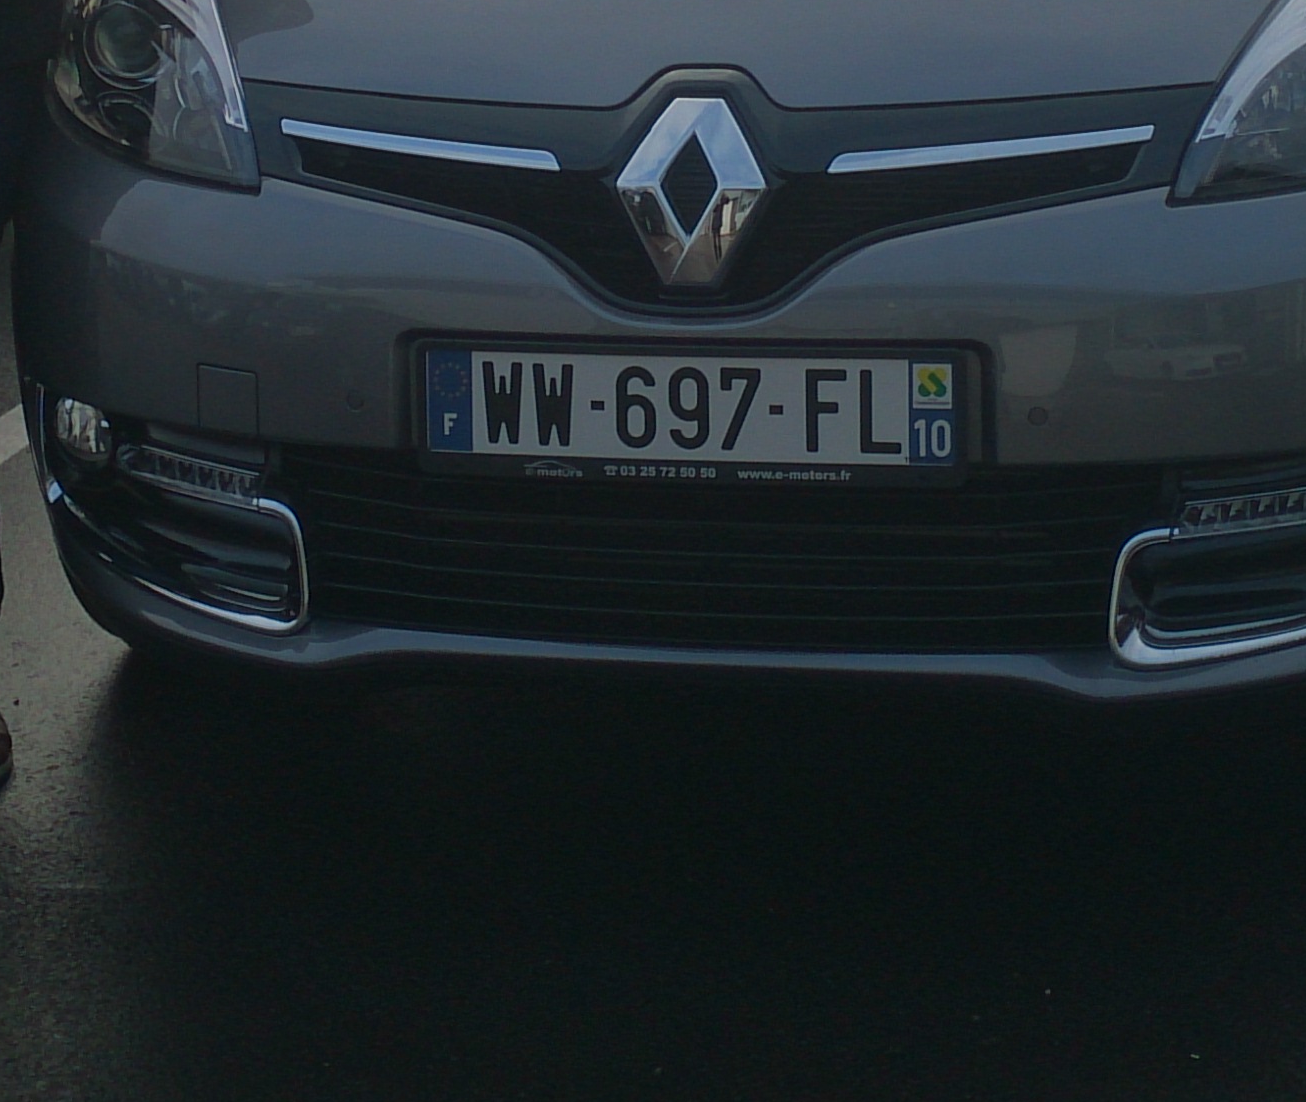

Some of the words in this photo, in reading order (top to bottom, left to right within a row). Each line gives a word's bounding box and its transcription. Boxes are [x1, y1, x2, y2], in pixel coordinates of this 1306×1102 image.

[443, 412, 458, 436] F
[482, 361, 902, 454] WW-697-FL
[914, 418, 952, 458] 10
